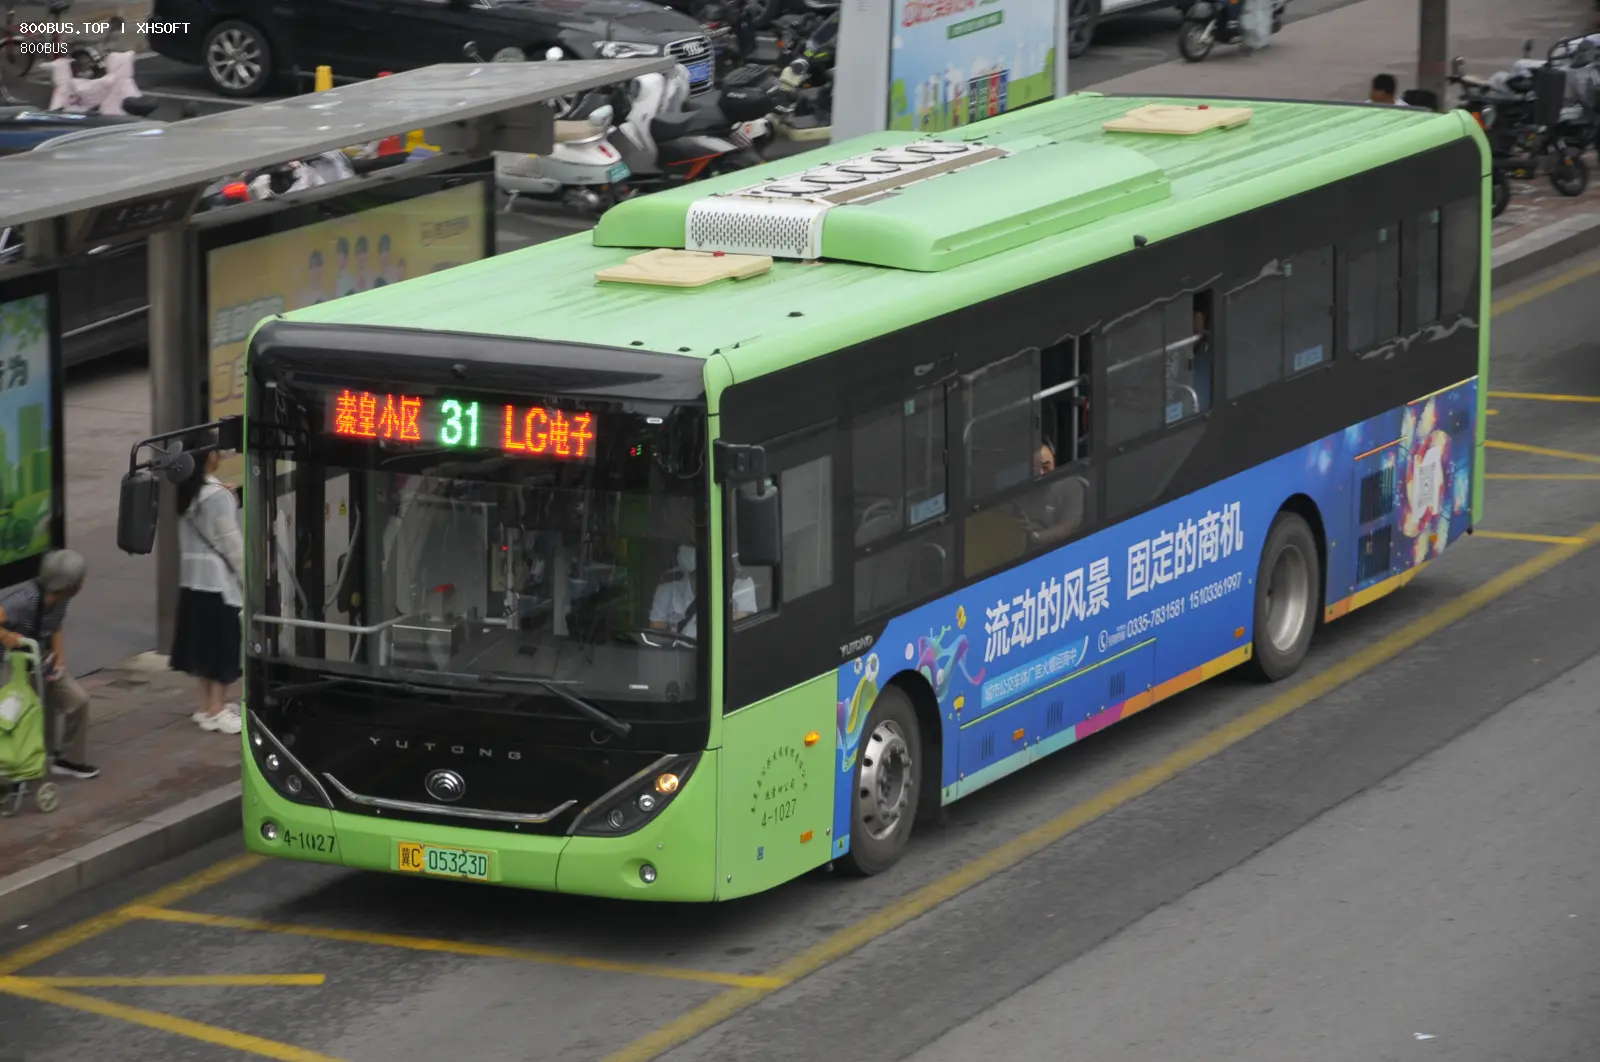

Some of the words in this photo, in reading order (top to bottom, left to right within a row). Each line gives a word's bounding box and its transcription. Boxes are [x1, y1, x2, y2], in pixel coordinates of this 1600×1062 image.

[333, 389, 422, 440] 秦皇小区
[440, 399, 478, 446] 31
[504, 407, 593, 457] LG电子
[984, 556, 1112, 664] 流动的风景
[1126, 500, 1244, 600] 固定的商机
[368, 736, 523, 761] YUTONG
[761, 797, 798, 828] 4-1027
[283, 829, 335, 853] 4-1027
[427, 848, 488, 878] 05323D
